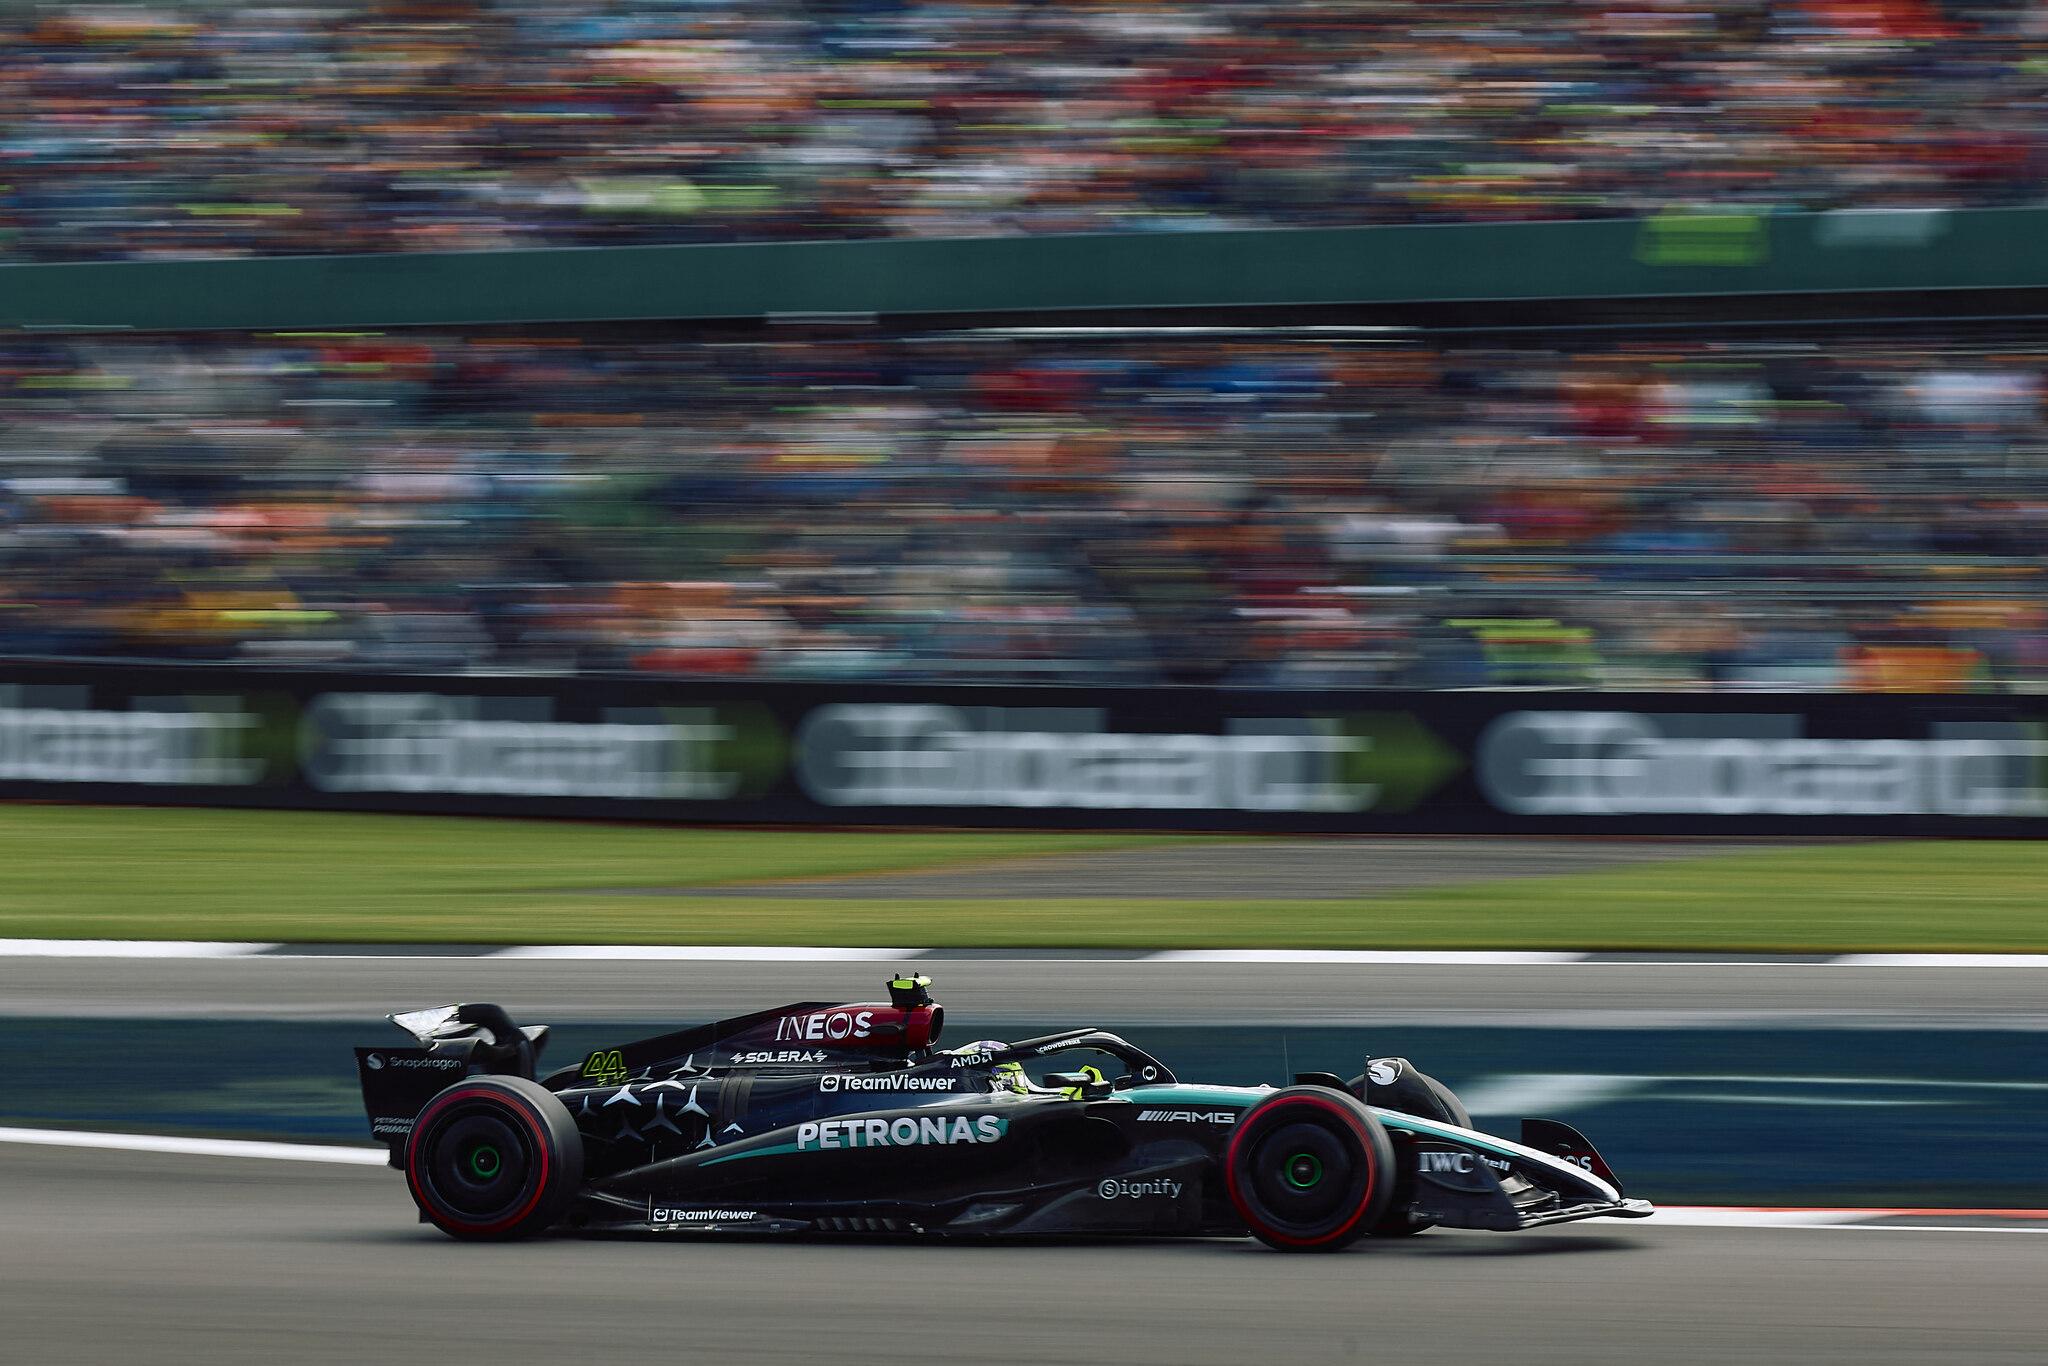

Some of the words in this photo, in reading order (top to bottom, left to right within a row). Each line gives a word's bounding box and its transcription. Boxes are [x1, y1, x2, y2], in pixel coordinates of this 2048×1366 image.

[774, 1011, 874, 1041] INEOS
[390, 1056, 462, 1071] Snapdragon
[583, 1050, 627, 1078] 44
[744, 1050, 813, 1063] SOLERA
[950, 1056, 981, 1069] AMD
[842, 1074, 956, 1091] TeamViewer
[1169, 1111, 1236, 1124] AMG
[797, 1115, 1001, 1150] PETRONAS
[1417, 1152, 1474, 1174] IWC
[671, 1209, 757, 1220] TeamViewer
